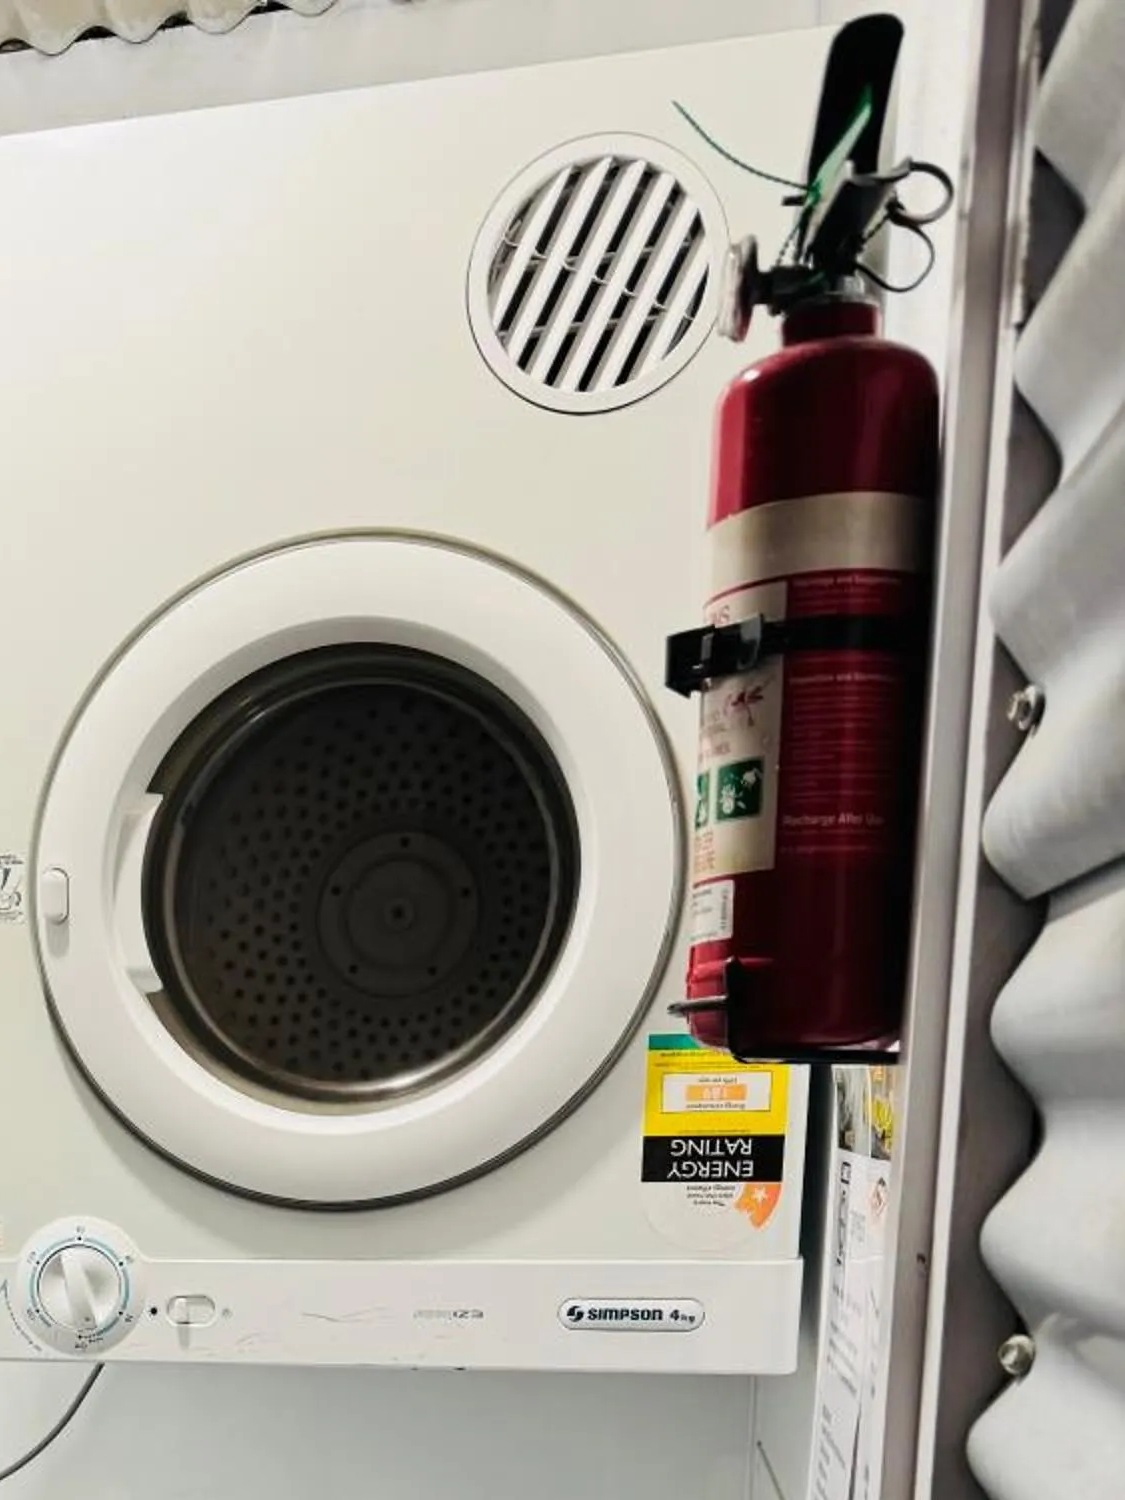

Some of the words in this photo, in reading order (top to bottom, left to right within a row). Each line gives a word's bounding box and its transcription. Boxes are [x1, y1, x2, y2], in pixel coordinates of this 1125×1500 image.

[671, 1138, 752, 1157] RATING
[666, 1160, 754, 1179] ENERGY
[587, 1308, 663, 1321] SIMPSON
